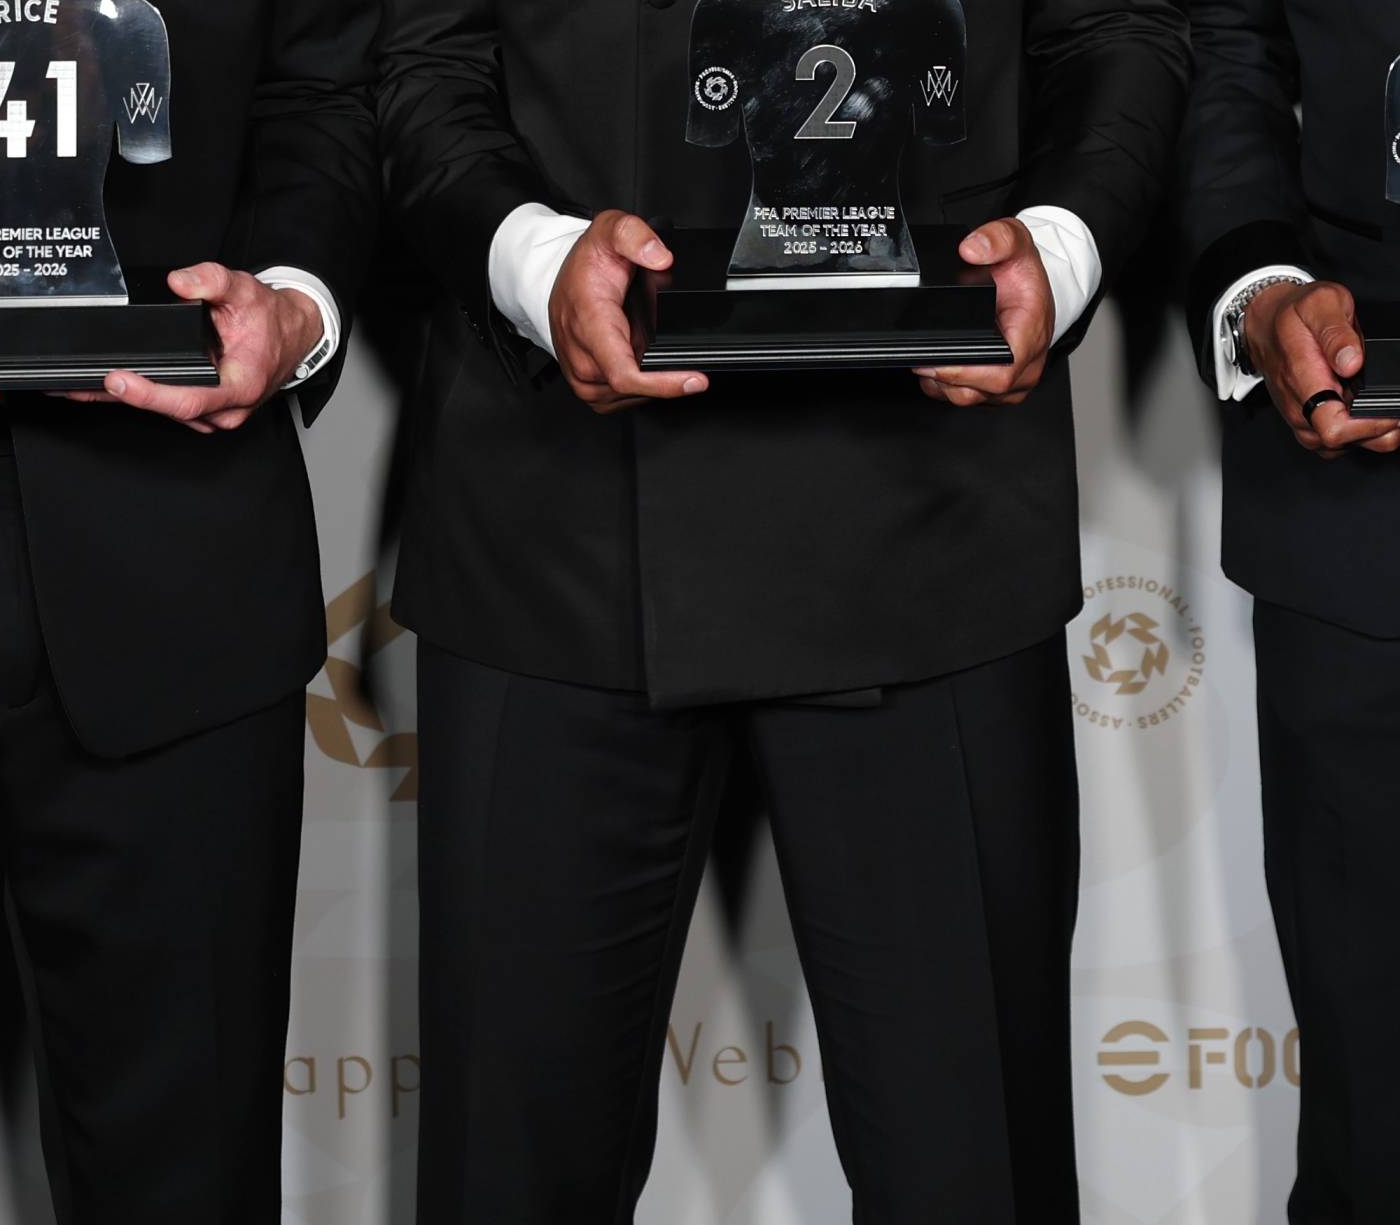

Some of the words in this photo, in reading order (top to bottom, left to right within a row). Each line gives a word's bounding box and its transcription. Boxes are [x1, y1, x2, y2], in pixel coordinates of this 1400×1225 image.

[794, 44, 857, 139] 2
[754, 207, 779, 220] PFA
[782, 207, 839, 220] PREMIER
[842, 206, 895, 219] LEAGUE
[46, 227, 100, 240] LEAGUE
[760, 224, 797, 237] TEAM
[802, 225, 820, 236] OF
[823, 224, 849, 236] THE
[851, 224, 887, 237] YEAR
[3, 246, 24, 258] OF
[27, 246, 53, 258] THE
[57, 245, 92, 258] YEAR
[784, 241, 817, 254] 2025
[830, 241, 863, 254] 2026
[34, 263, 68, 276] 2026
[1083, 576, 1189, 617] OFESSIONAL
[1137, 626, 1205, 728] FOOTBALLERS
